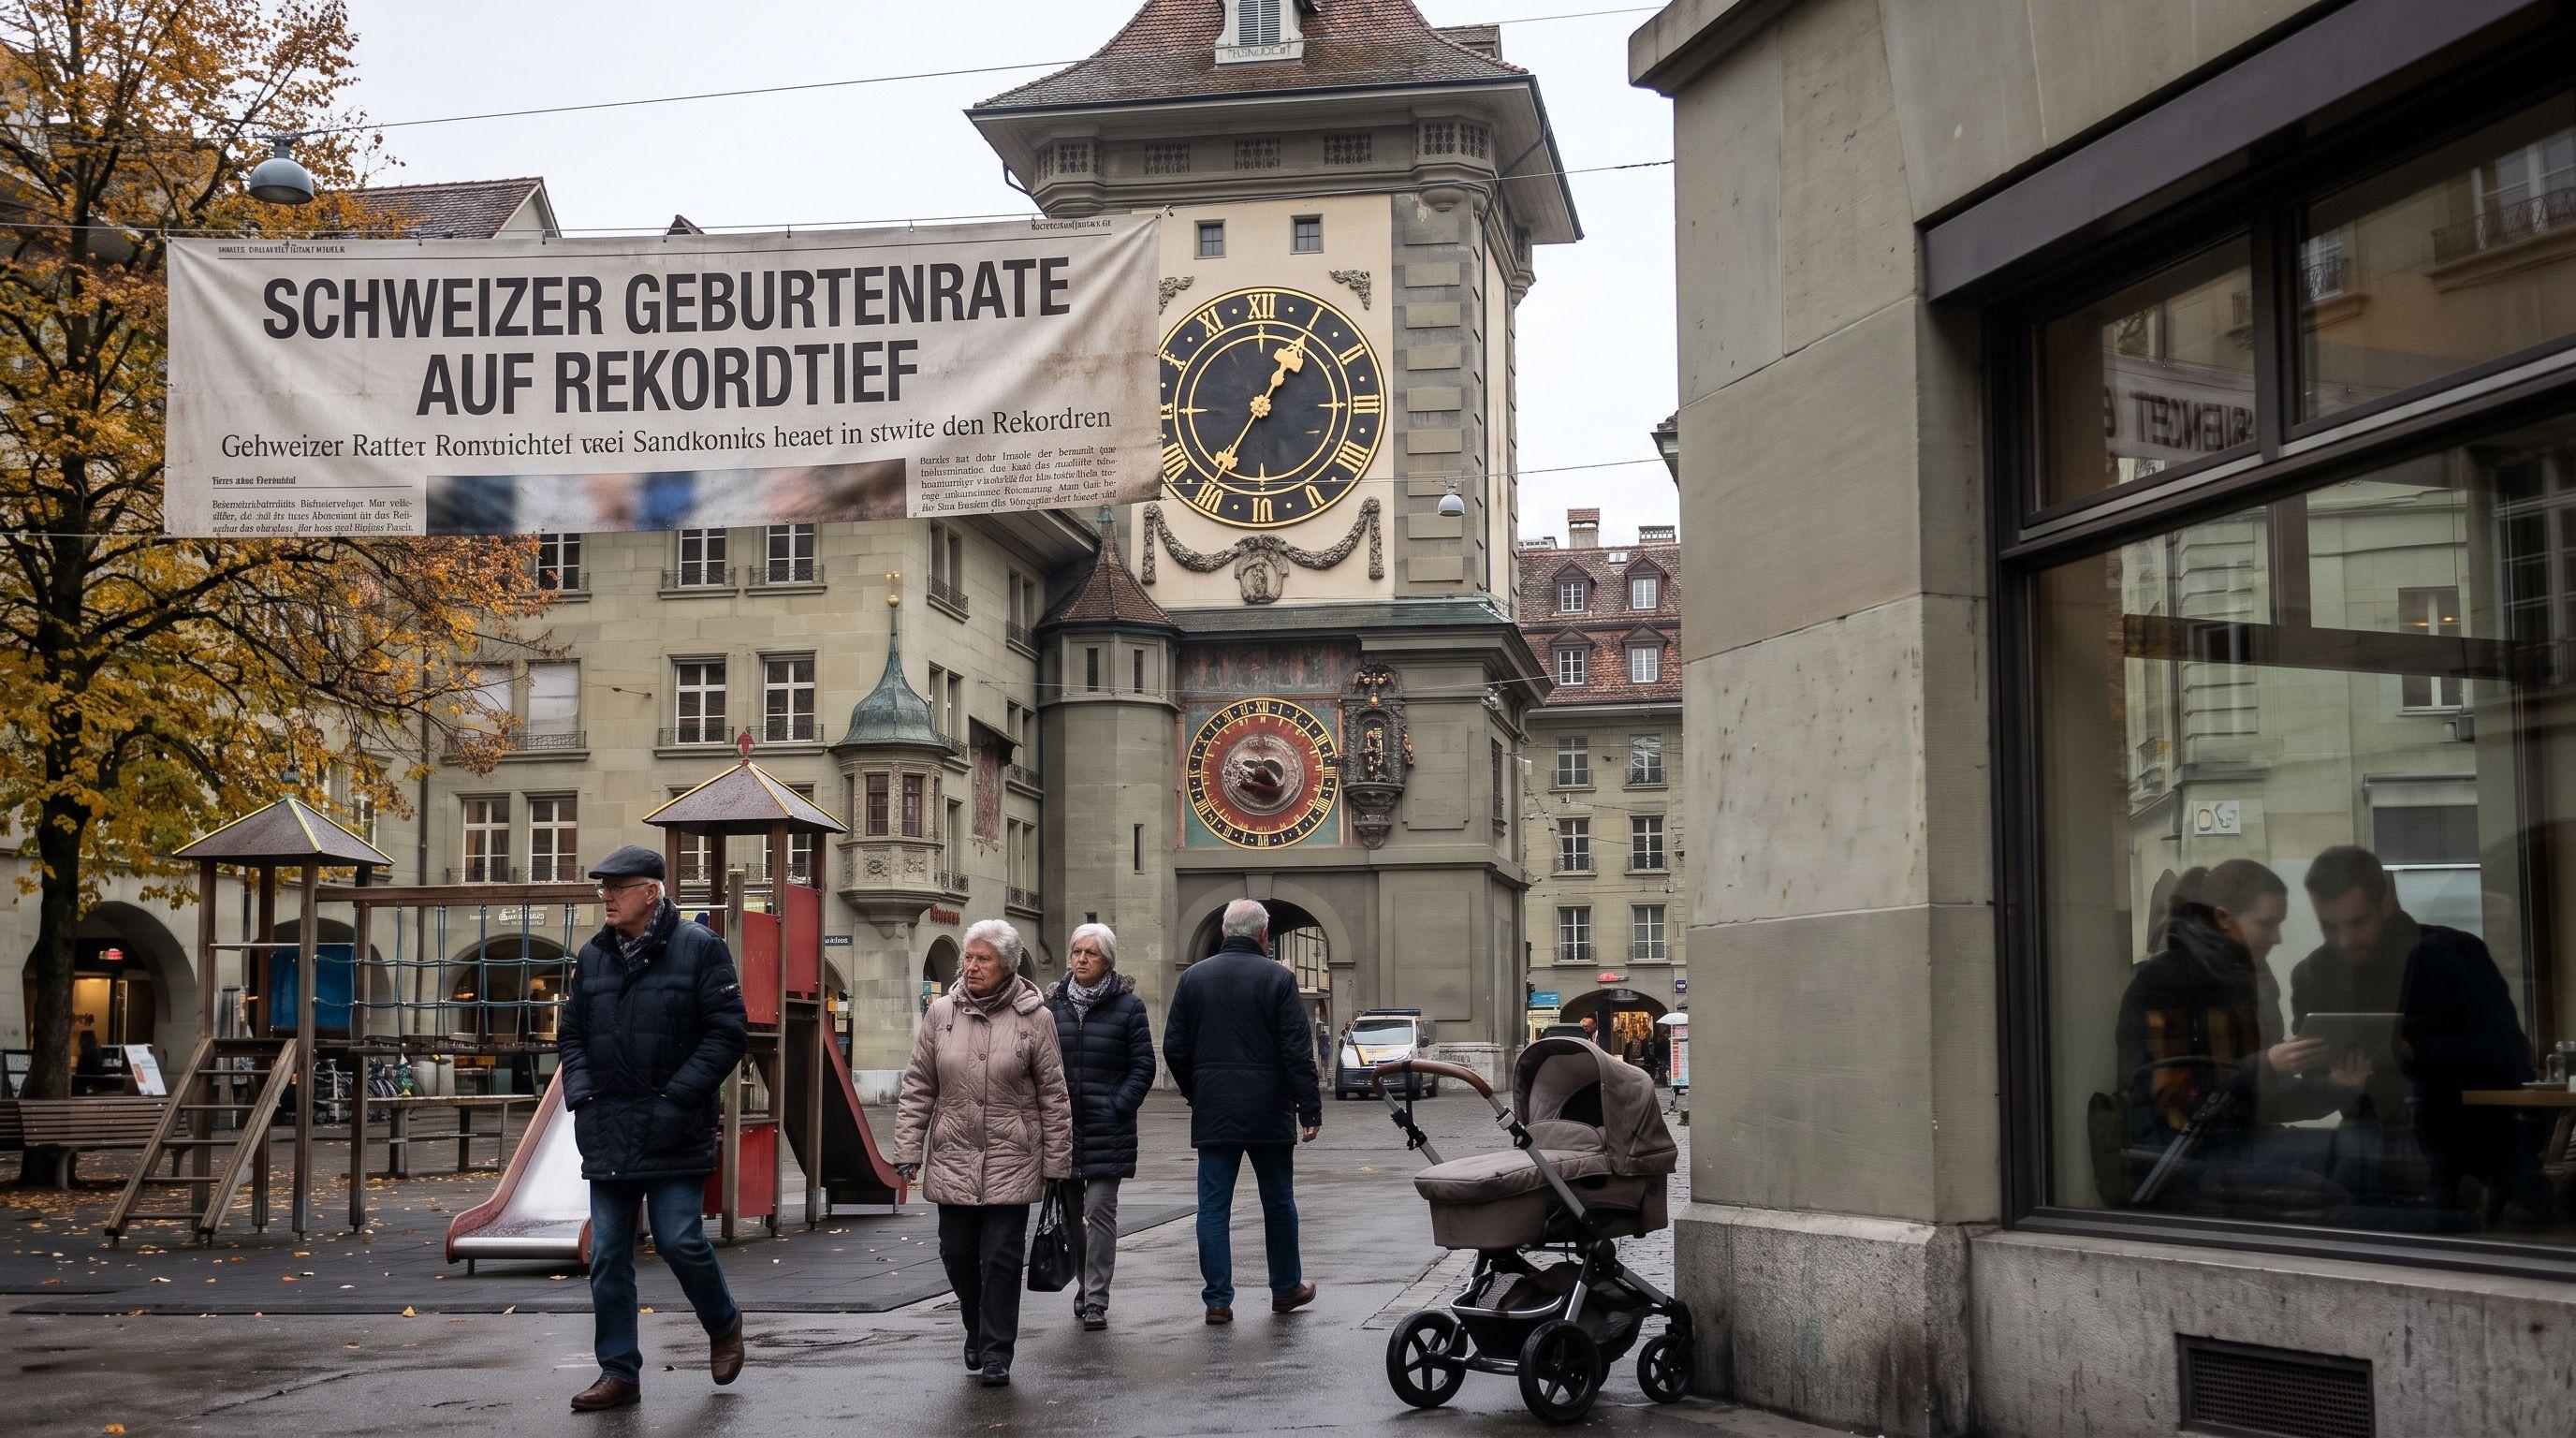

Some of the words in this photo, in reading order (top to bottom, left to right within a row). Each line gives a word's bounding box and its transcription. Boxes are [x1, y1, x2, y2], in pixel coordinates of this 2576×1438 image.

[263, 276, 605, 340] SCHWEIZER
[625, 257, 1071, 335] GEBURTENRATE
[416, 352, 534, 417] AUF
[555, 339, 918, 414] REKORDTIEF
[222, 433, 344, 458] Gehweizer
[774, 425, 834, 448] heaet
[842, 422, 863, 445] in
[871, 420, 935, 443] stwite
[943, 415, 985, 438] den
[992, 410, 1112, 434] Rekordren
[1037, 449, 1052, 458] der
